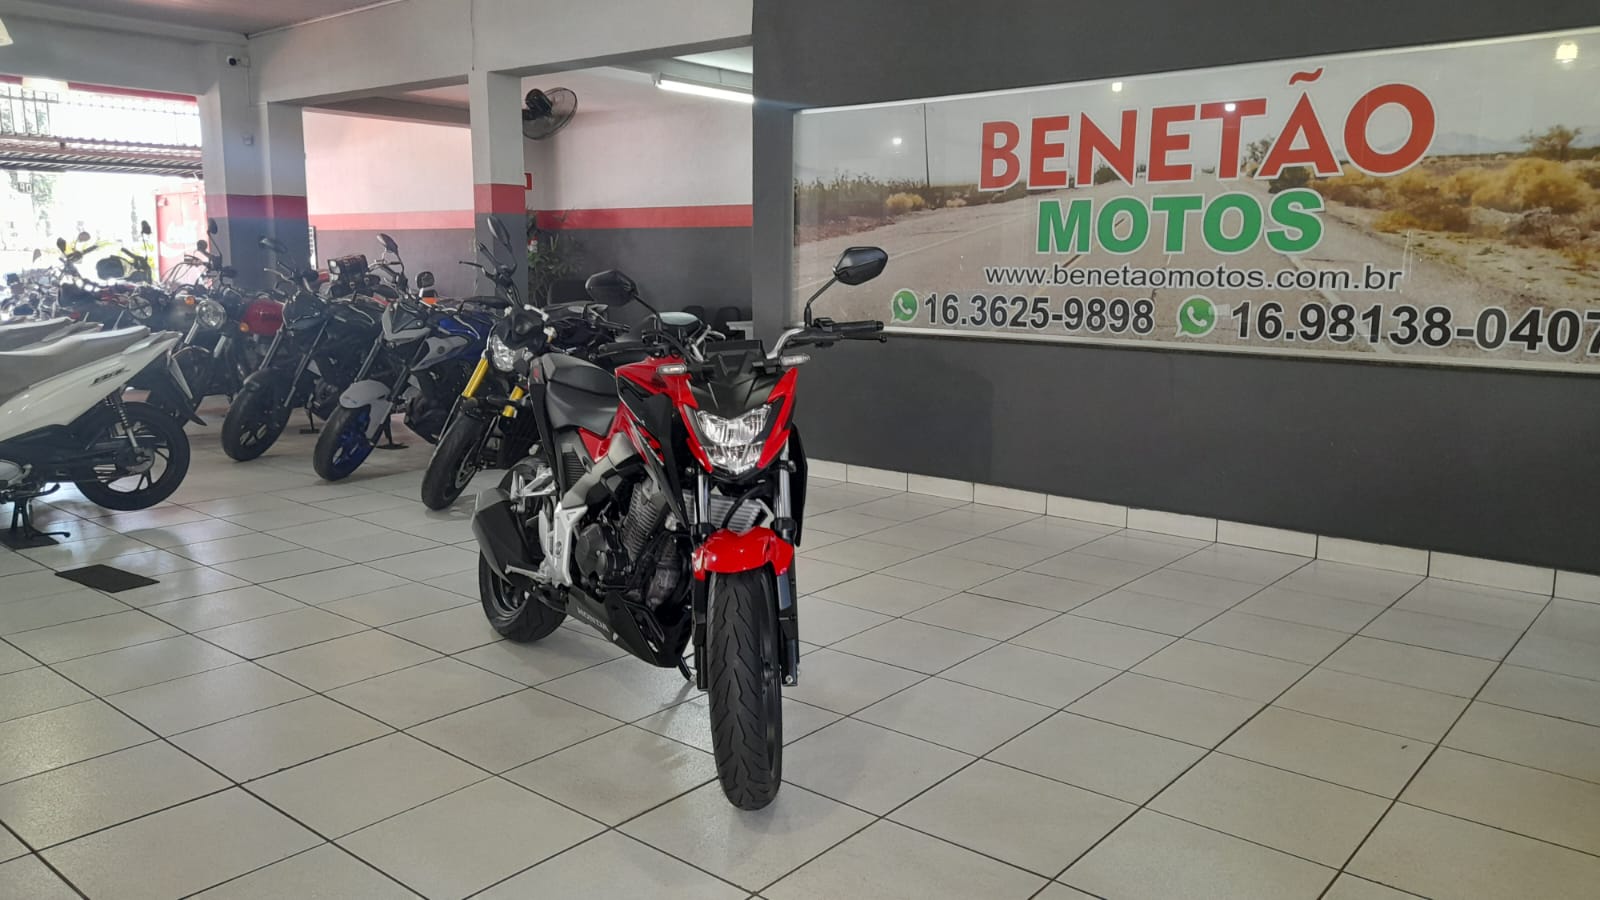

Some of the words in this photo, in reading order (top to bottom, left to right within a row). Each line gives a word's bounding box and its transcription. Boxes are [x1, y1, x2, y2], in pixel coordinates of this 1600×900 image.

[979, 67, 1436, 192] BENETÃO
[1036, 189, 1325, 256] MOTOS
[985, 264, 1403, 291] www.benetaomotos.com.br
[925, 293, 1154, 334] 16.3625-9898
